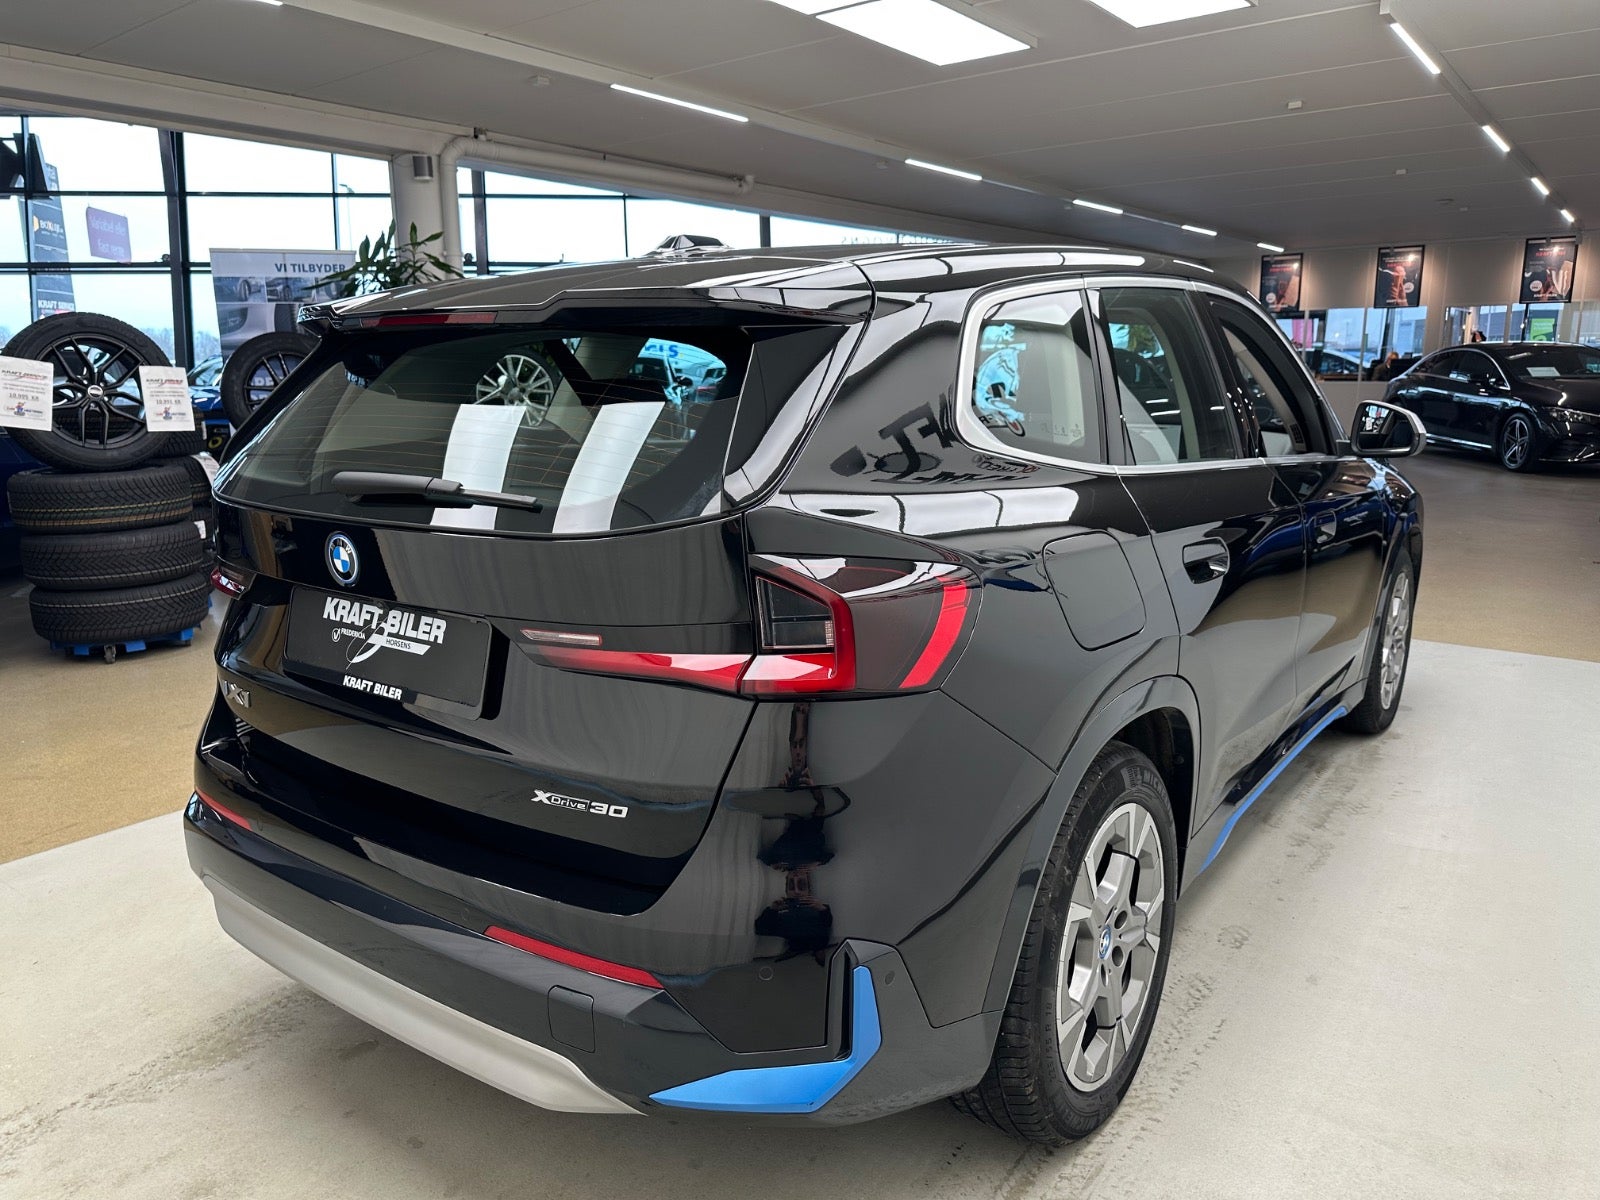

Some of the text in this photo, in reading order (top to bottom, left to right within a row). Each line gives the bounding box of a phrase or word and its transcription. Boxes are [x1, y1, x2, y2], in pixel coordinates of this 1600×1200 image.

[275, 263, 346, 272] VI TILBYDER
[323, 597, 447, 644] KRAFT BILER
[385, 638, 411, 650] HORSENS
[343, 674, 403, 701] KRAFT BILER
